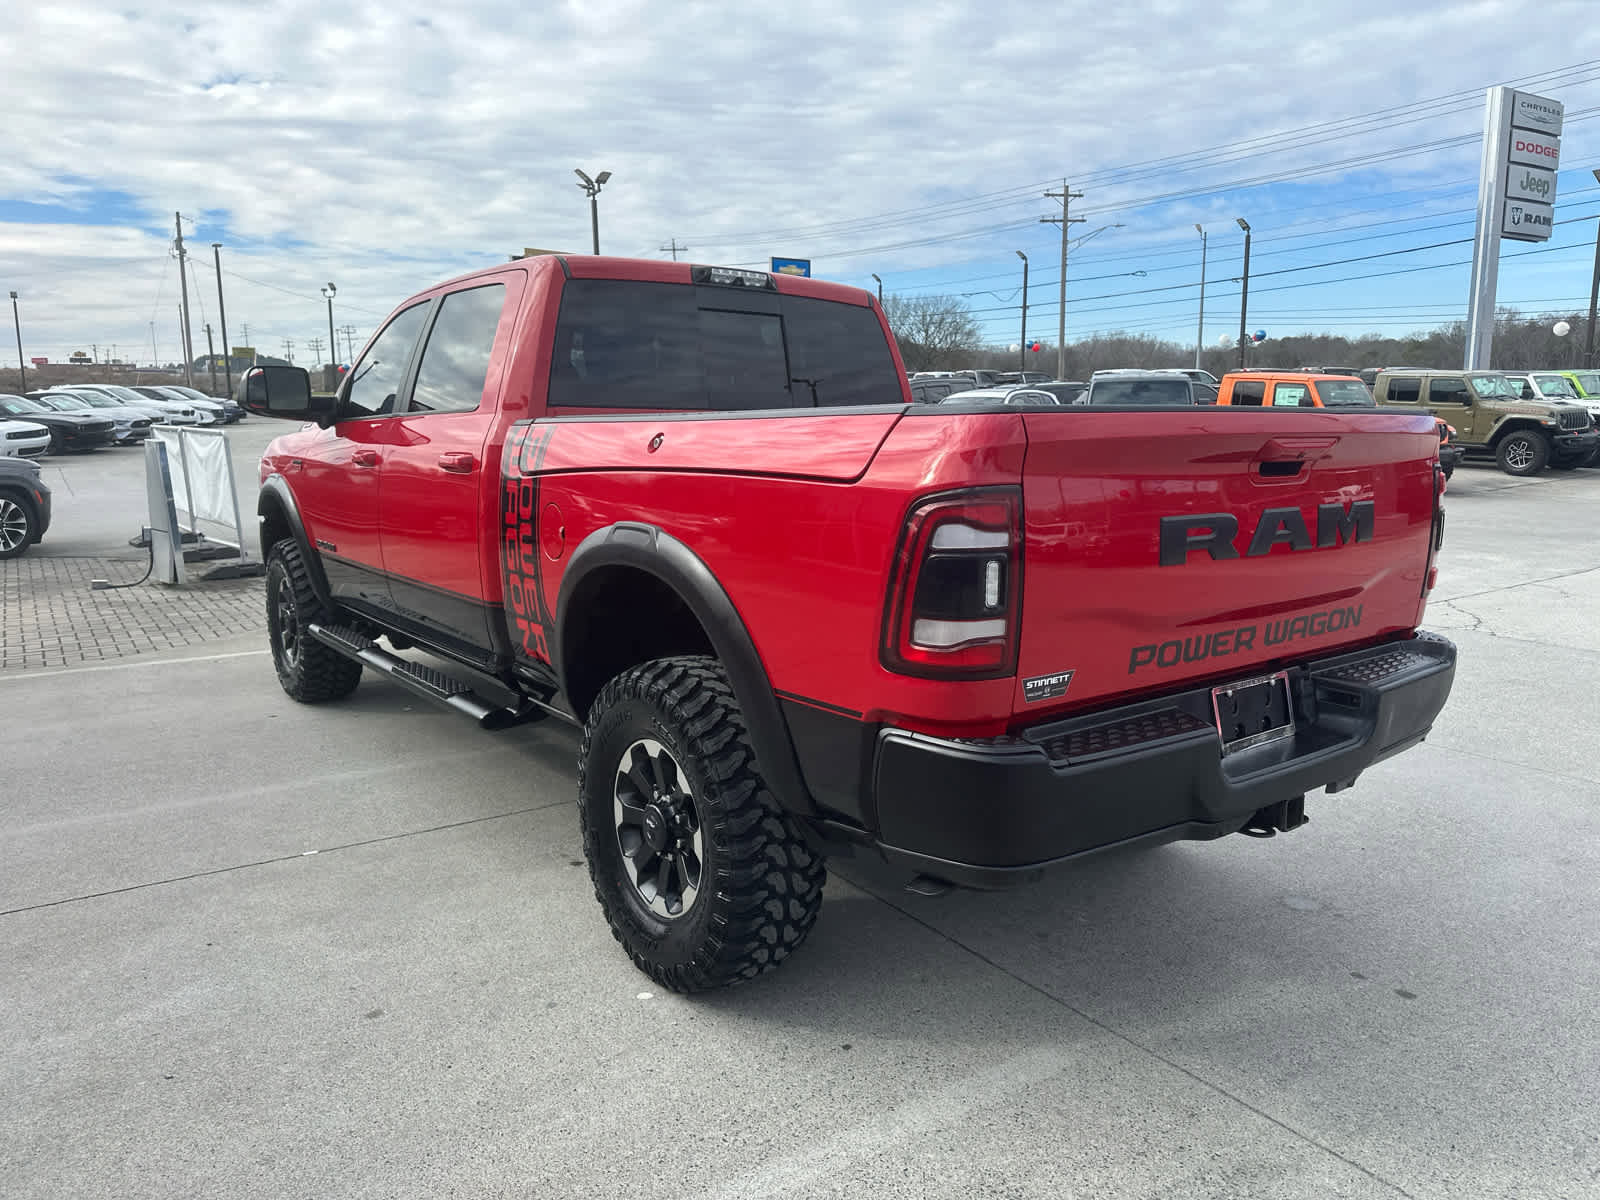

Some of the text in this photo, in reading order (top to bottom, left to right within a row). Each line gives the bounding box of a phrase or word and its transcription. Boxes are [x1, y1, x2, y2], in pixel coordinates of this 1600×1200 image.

[1520, 101, 1561, 116] CHRYSLER
[1515, 141, 1559, 159] DODGE
[1519, 171, 1550, 198] Jeep
[1523, 211, 1552, 227] RAM
[1159, 500, 1375, 567] RAM
[1128, 604, 1364, 675] POWER WAGON
[1025, 673, 1070, 689] STINNETT
